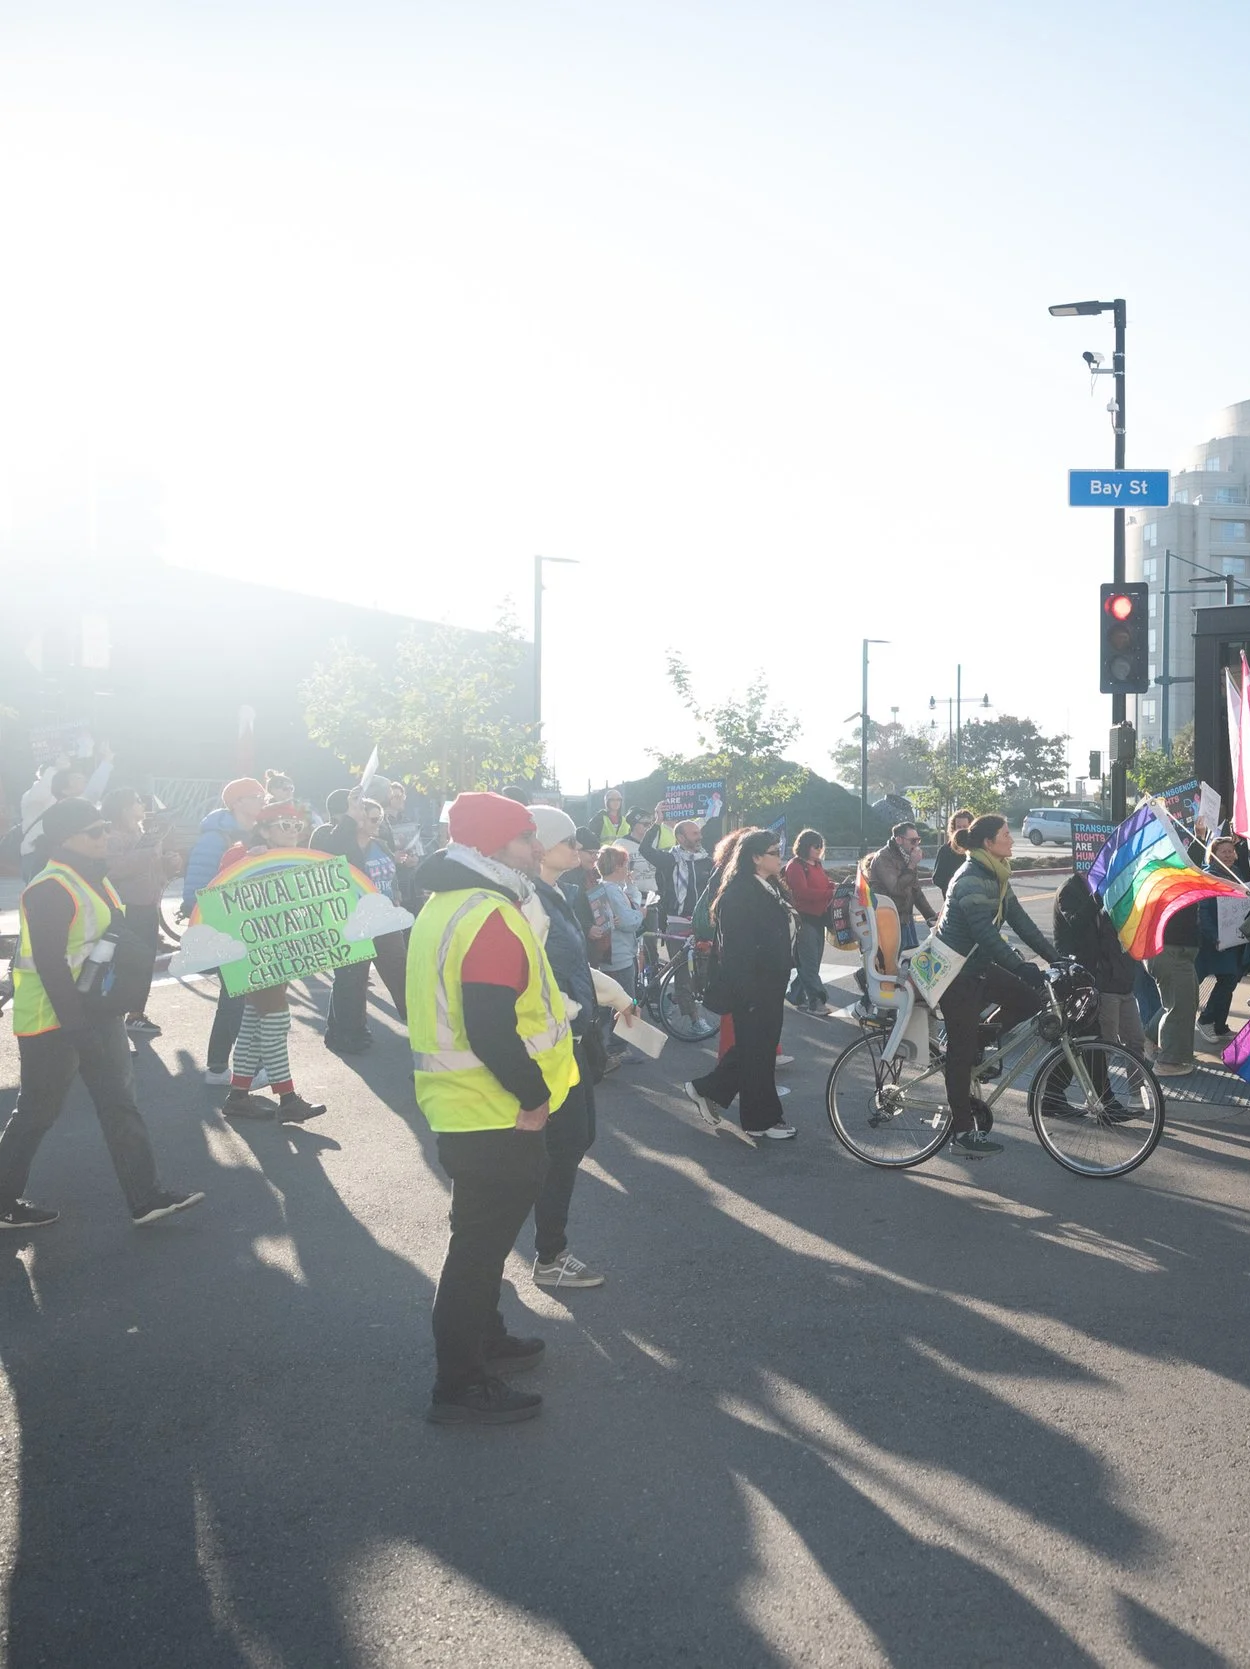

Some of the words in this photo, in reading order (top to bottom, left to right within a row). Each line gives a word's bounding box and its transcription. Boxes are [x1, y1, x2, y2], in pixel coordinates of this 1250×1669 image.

[1090, 480, 1122, 498] Bay
[1129, 480, 1148, 494] St
[666, 782, 723, 792] TRANSGENDER
[1074, 824, 1114, 833] TRANSGE
[1074, 833, 1105, 842] RIGHTS
[1075, 842, 1093, 851] ARE
[1076, 851, 1095, 860] HUM
[294, 863, 350, 902] ETHICS
[240, 910, 284, 944] ONLY
[282, 901, 326, 936] APPLY
[326, 896, 348, 924] TO
[247, 928, 341, 967] CIS-GENDERED
[248, 944, 352, 986] CHILDREN?
